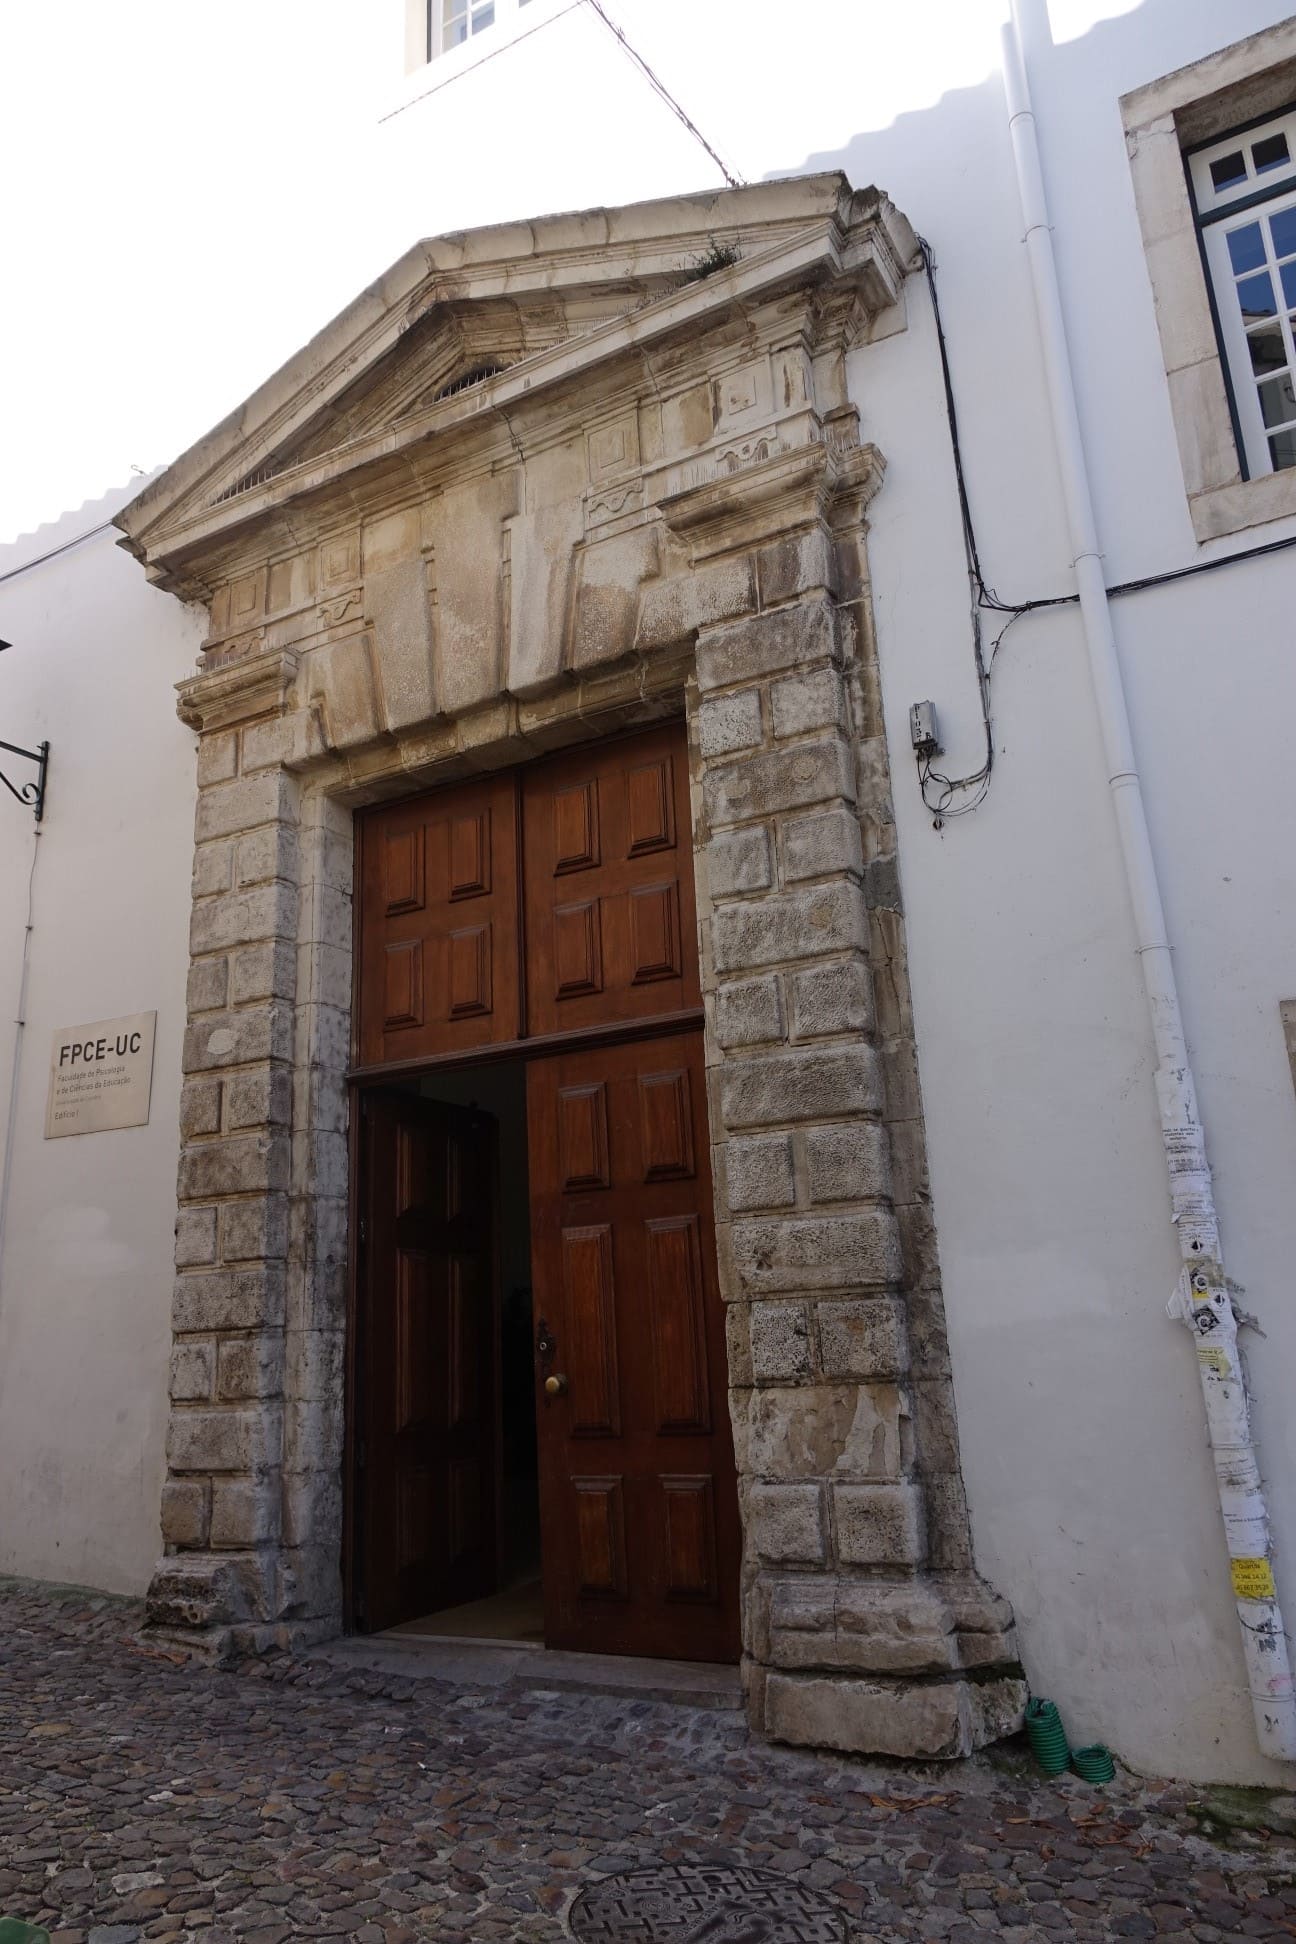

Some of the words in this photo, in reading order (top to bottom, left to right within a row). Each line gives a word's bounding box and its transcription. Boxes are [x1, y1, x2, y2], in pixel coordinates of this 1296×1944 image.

[59, 1032, 141, 1067] FPCE-UC
[57, 1071, 86, 1082] Faculdade
[87, 1070, 95, 1078] de
[95, 1066, 125, 1076] Psicologia
[61, 1086, 69, 1094] de
[103, 1076, 131, 1087] Educação
